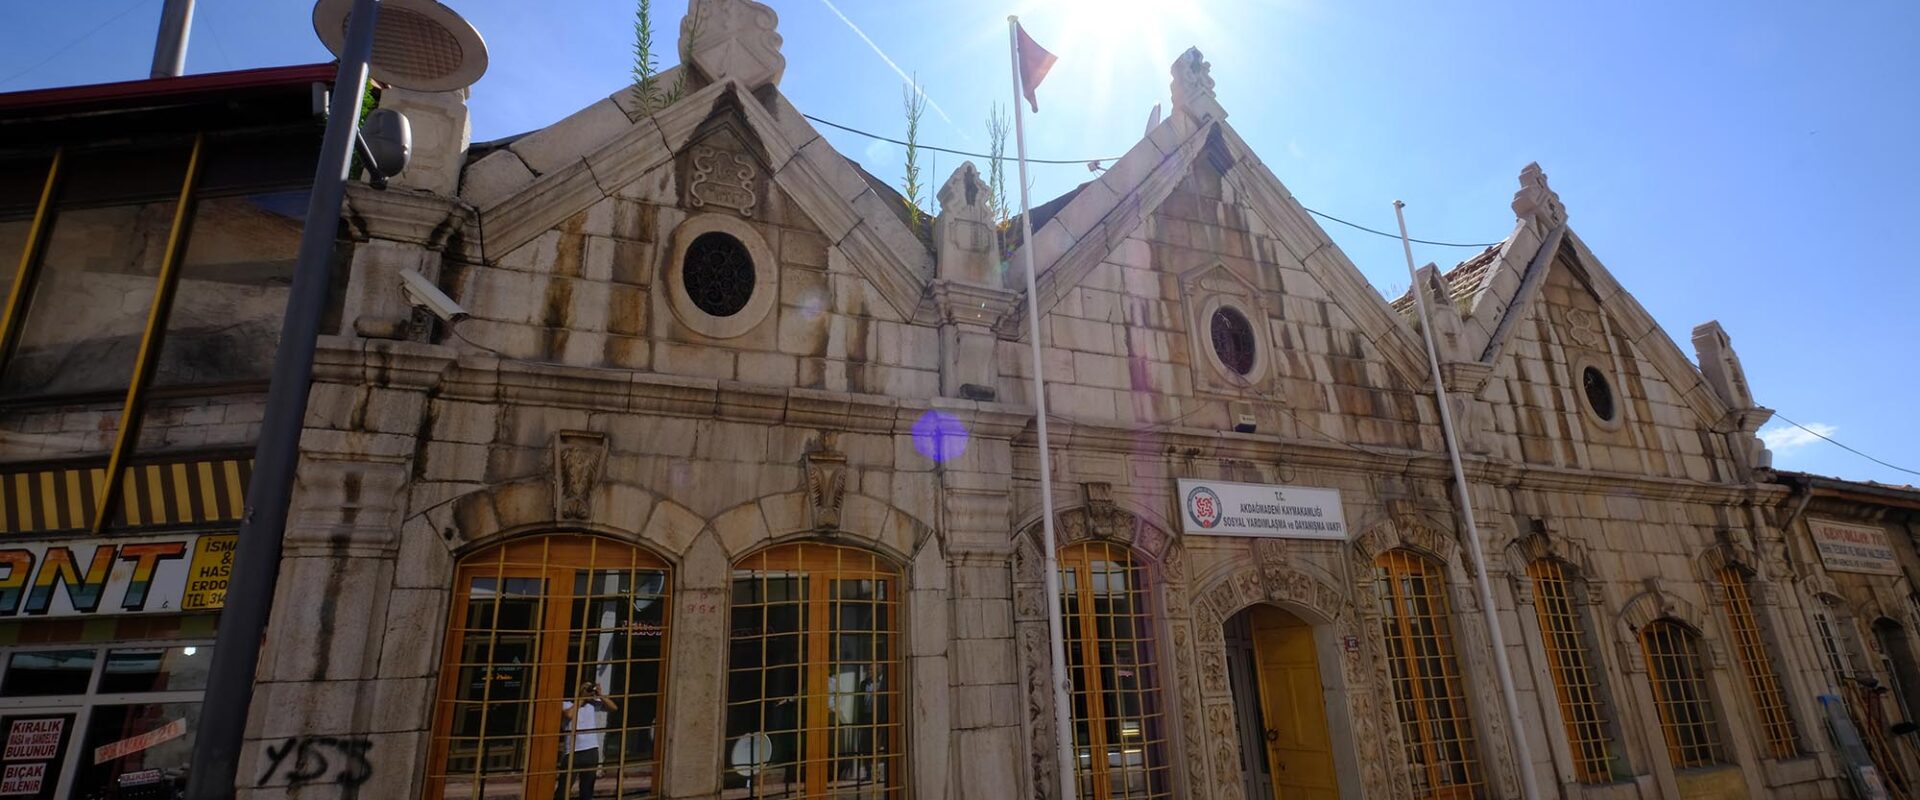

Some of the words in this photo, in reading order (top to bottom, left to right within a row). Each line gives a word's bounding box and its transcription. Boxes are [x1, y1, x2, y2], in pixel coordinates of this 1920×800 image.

[1240, 502, 1281, 515] AKDAĞMADENİ
[1281, 504, 1323, 517] KAYMAKAMLIĞI
[1223, 516, 1246, 528] SOSYAL
[1246, 517, 1287, 531] YARDIMLAŞMA
[1294, 519, 1326, 533] DAYANIŞMA
[221, 551, 232, 565] &
[13, 720, 61, 733] KİRALIK
[6, 745, 55, 757] BULUNUR
[6, 765, 43, 780] BIÇAK
[2, 780, 40, 793] BİLENİR
